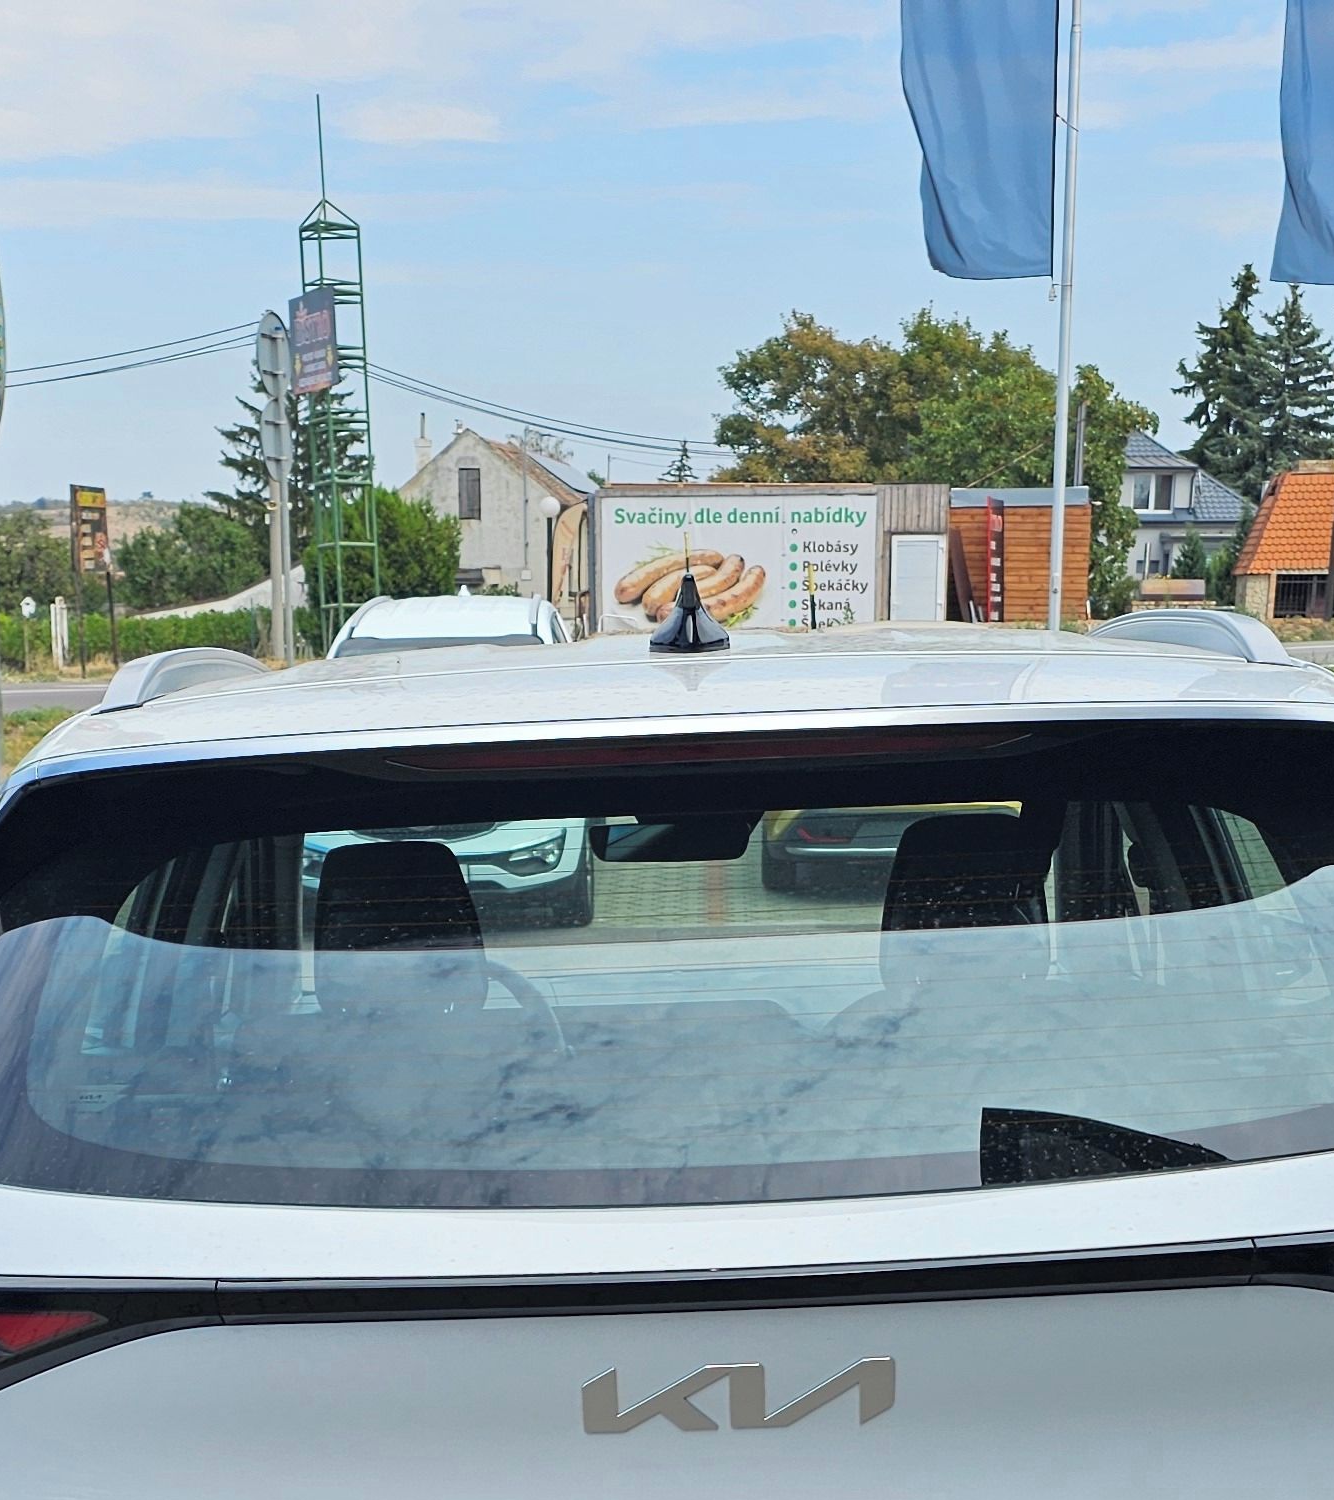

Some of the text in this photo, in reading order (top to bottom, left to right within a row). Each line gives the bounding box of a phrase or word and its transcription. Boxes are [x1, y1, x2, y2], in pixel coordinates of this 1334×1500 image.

[614, 506, 867, 528] Svačiny dle denní nabídky
[802, 540, 859, 556] Klobásy
[801, 598, 851, 611] Skaná
[581, 1356, 896, 1434] KIA
